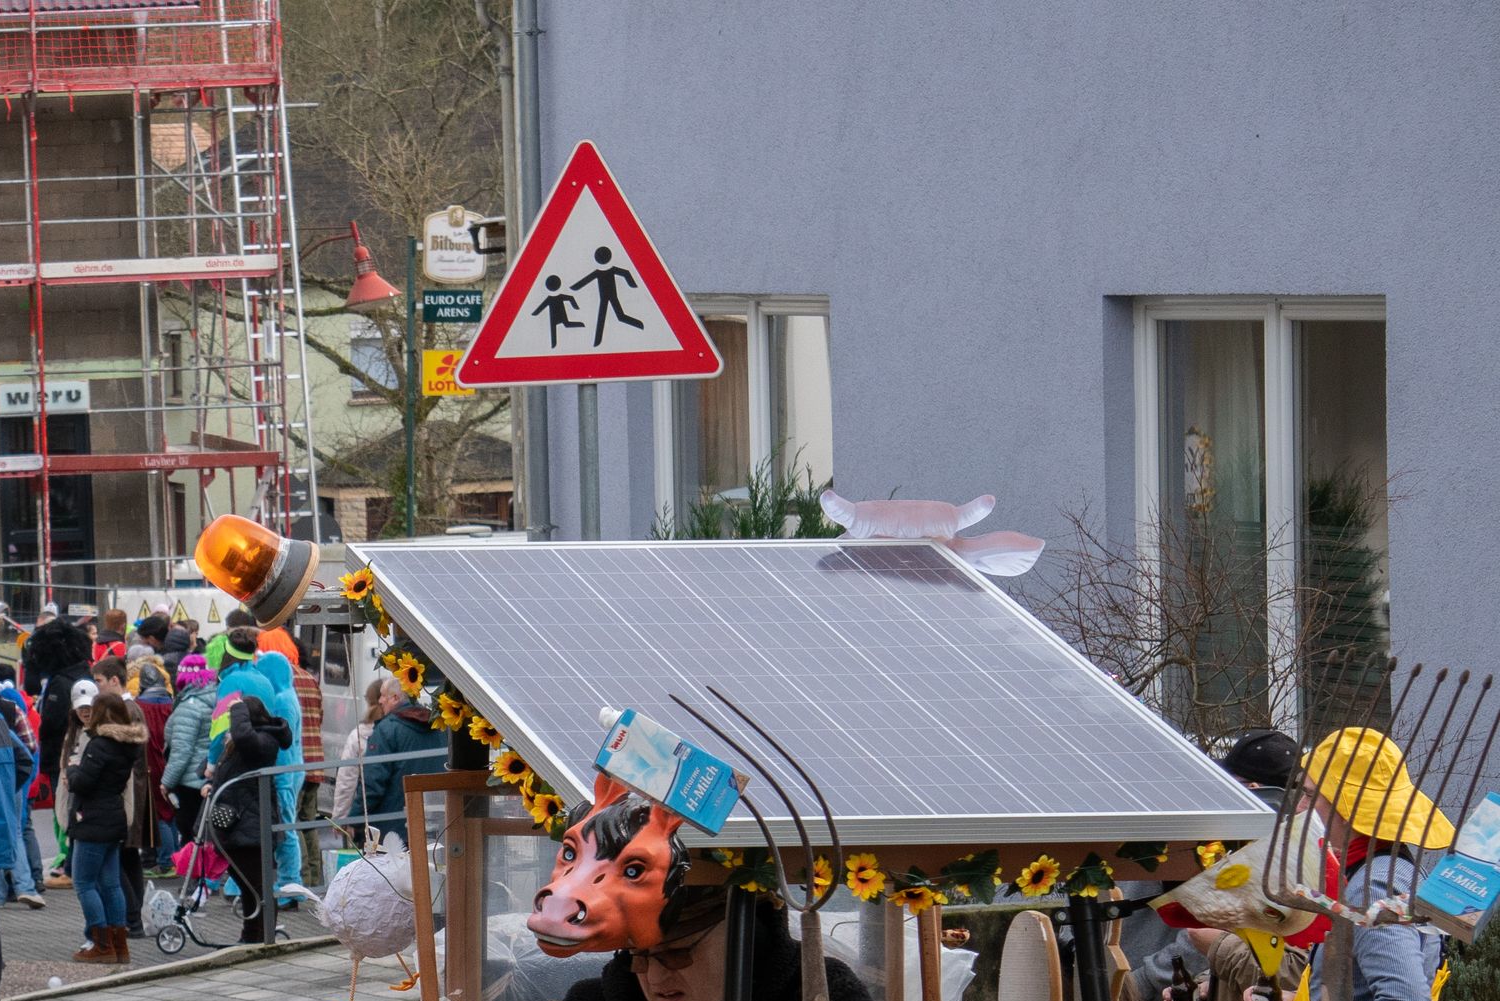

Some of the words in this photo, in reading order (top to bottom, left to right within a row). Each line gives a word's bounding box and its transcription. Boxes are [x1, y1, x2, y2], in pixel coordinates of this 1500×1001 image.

[73, 264, 113, 273] dahm.de
[204, 258, 245, 268] dahm.de
[425, 295, 454, 305] EURO
[456, 295, 481, 305] CAFE
[436, 307, 470, 318] ARENS
[7, 389, 82, 405] weru
[685, 765, 719, 812] H-Milch
[1440, 867, 1489, 898] H-Milch
